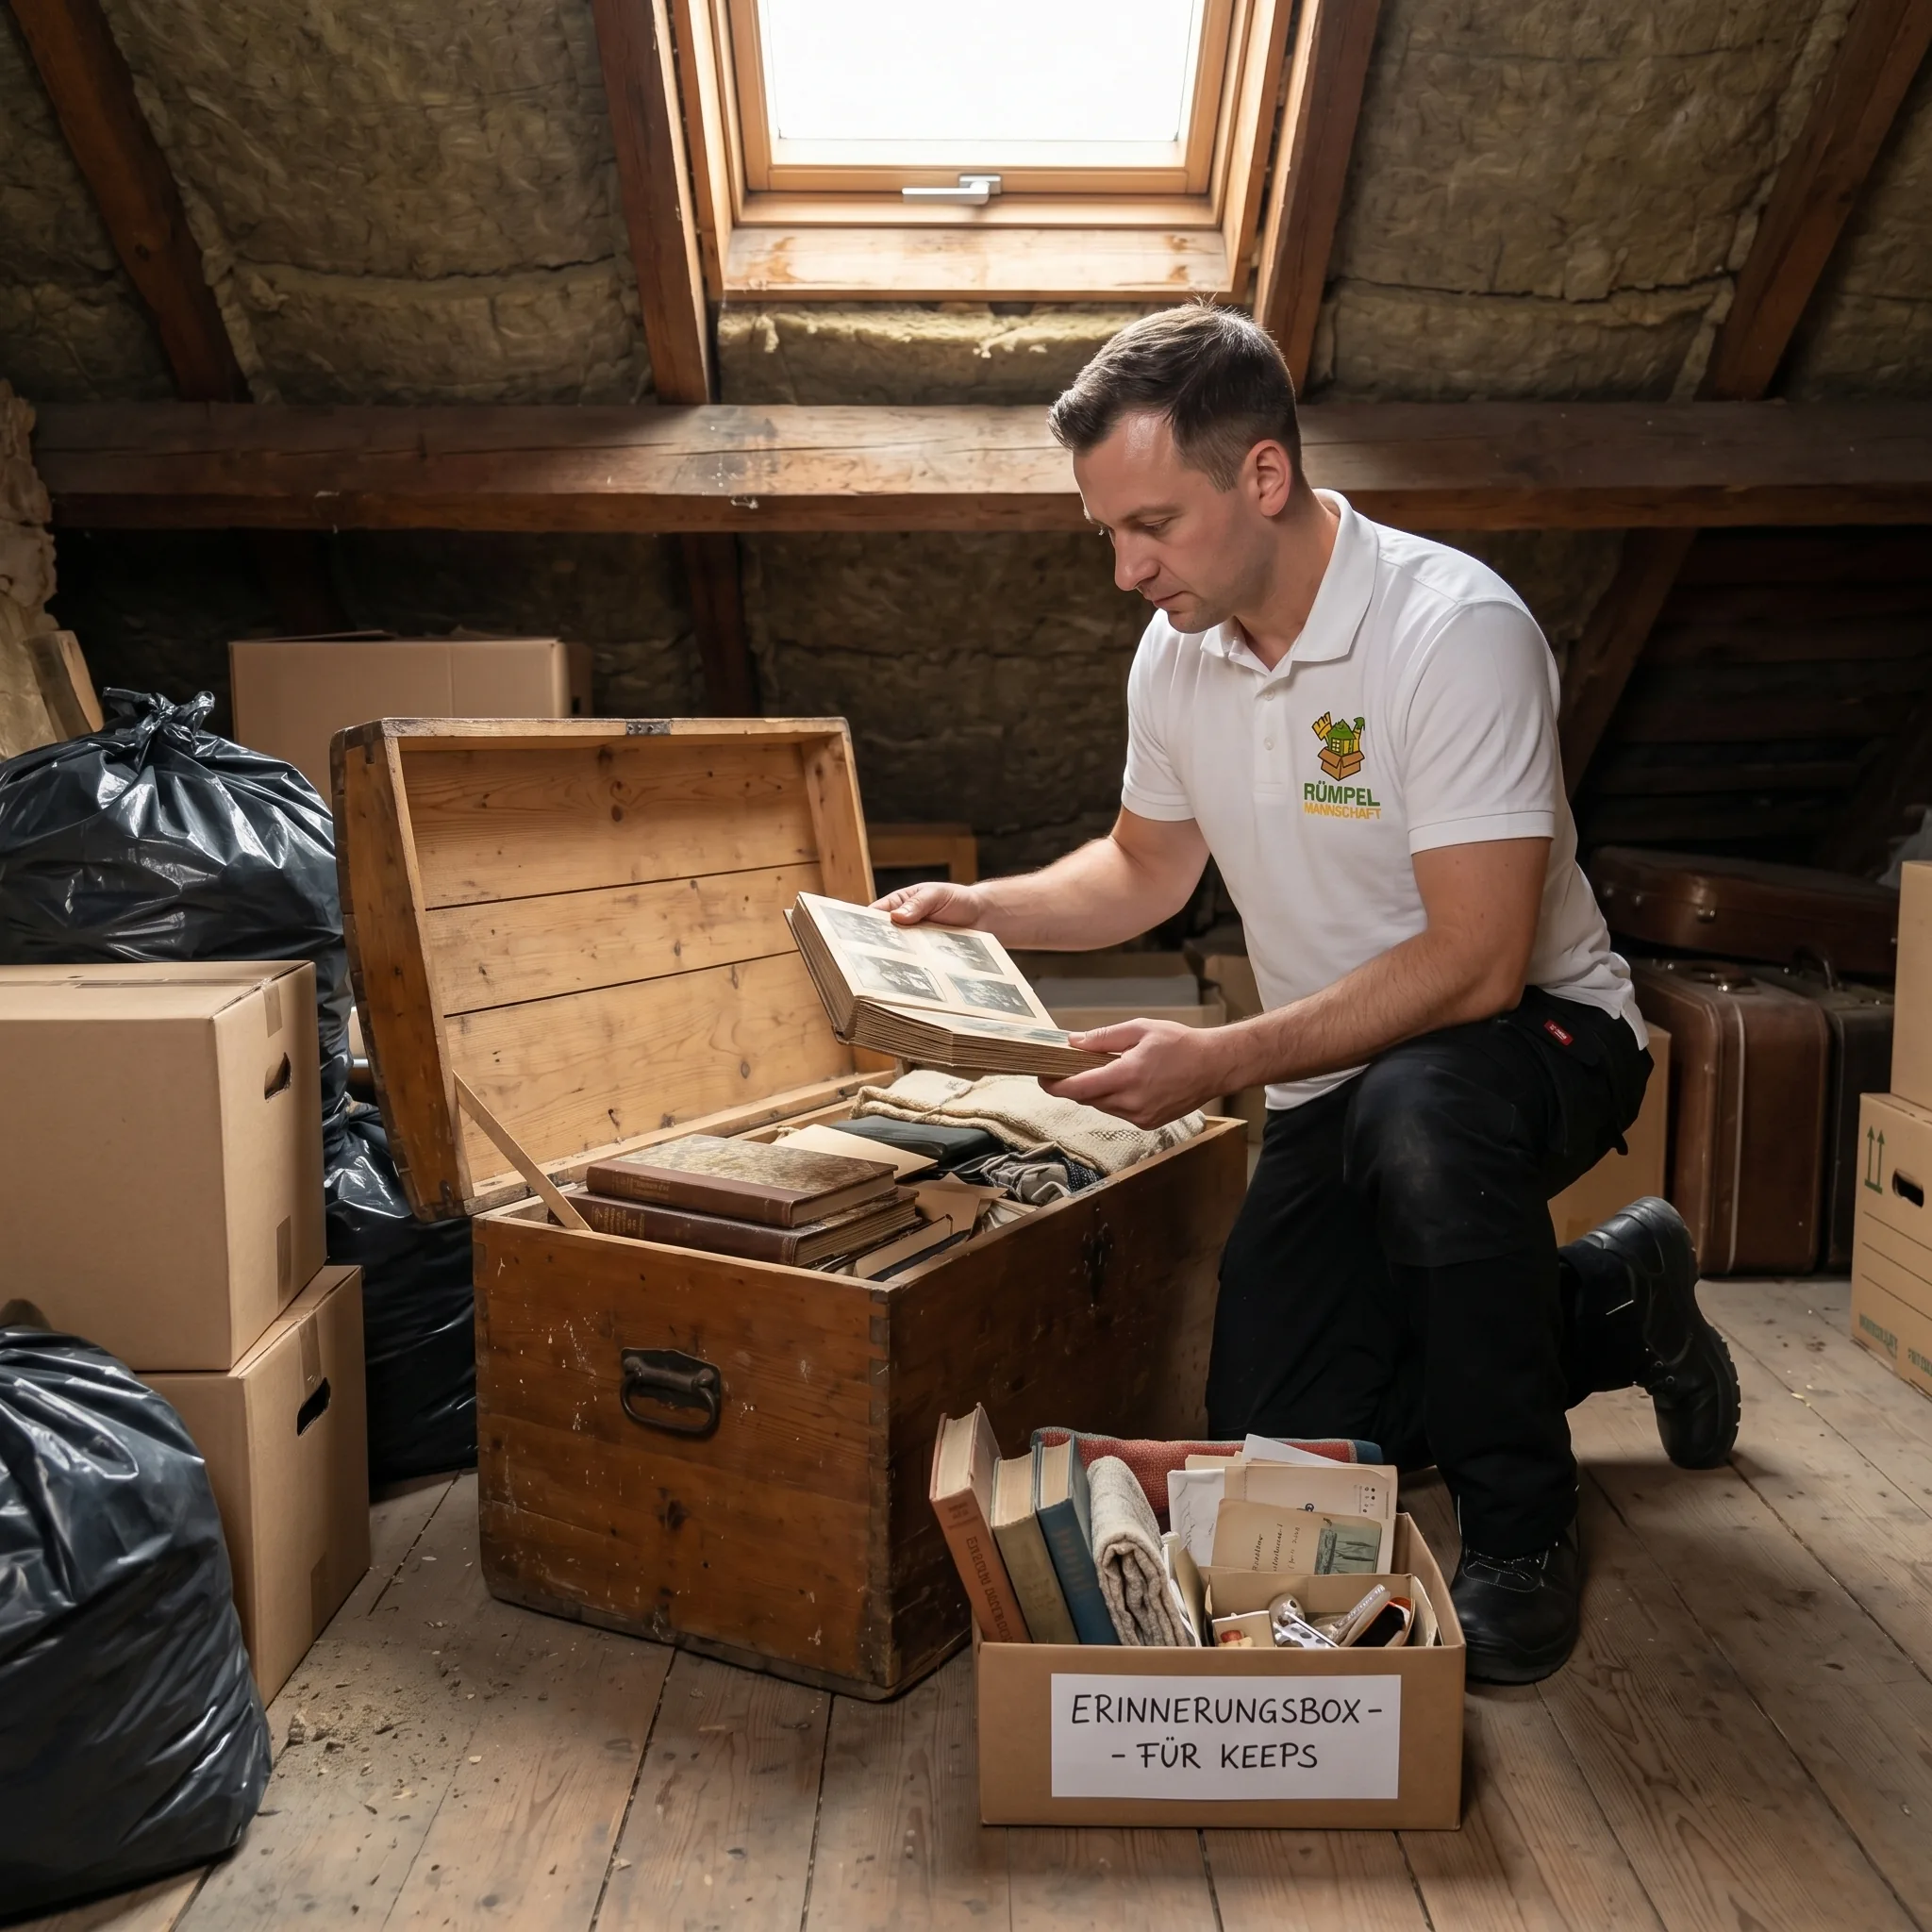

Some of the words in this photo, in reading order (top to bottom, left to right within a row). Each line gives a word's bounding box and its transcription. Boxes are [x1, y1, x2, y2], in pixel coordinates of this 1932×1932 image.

[1304, 780, 1380, 807] RÜMPEL
[1304, 802, 1381, 820] MANNSCHAFT
[1221, 1743, 1318, 1769] KEEPS
